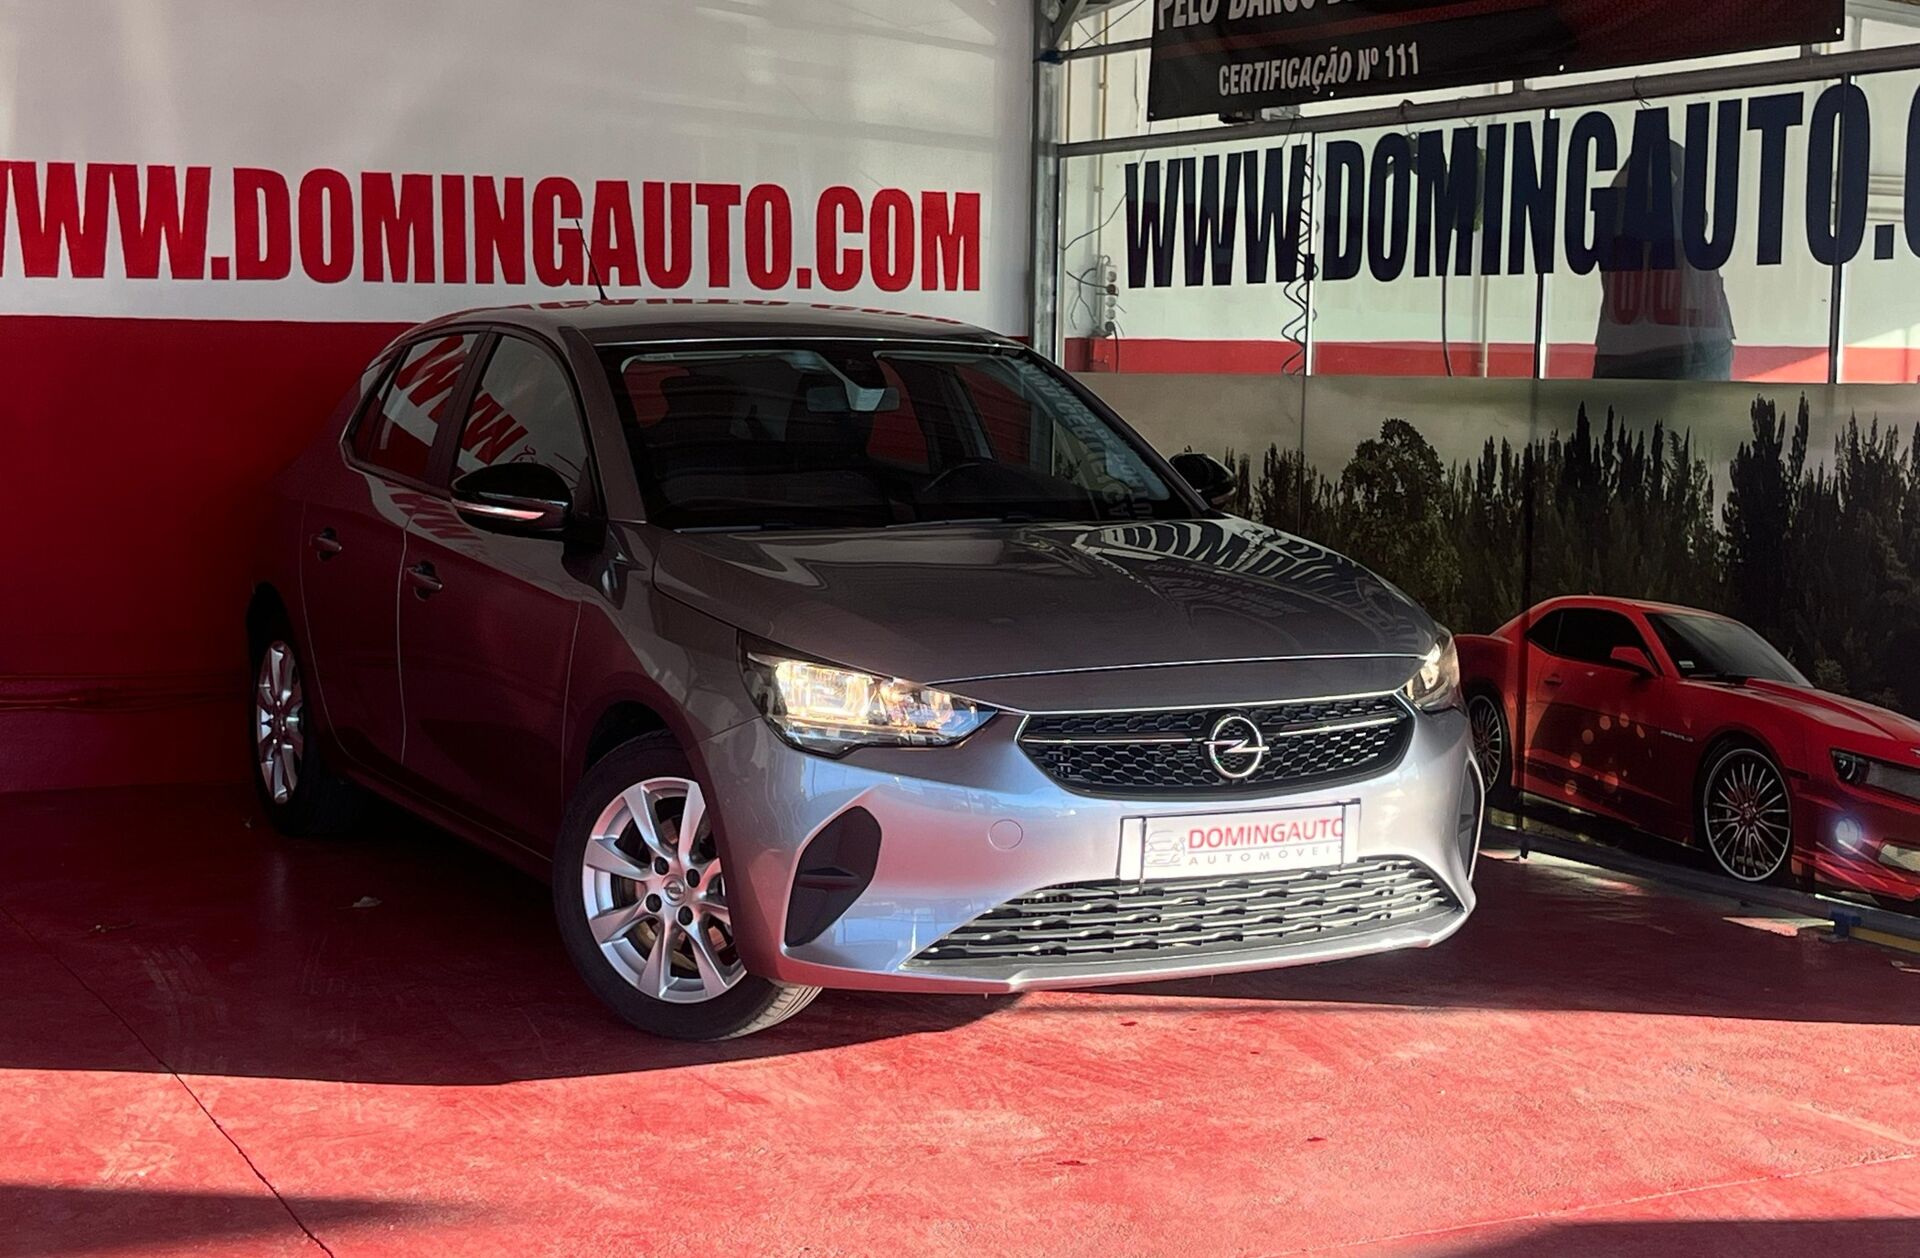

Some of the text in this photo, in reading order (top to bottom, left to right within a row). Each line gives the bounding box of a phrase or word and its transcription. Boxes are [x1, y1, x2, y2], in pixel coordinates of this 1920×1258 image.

[1219, 46, 1352, 96] CERTIFICAÇÃO
[1385, 41, 1419, 78] 111
[0, 161, 980, 292] WW.DOMINGAUTO.COM
[1125, 84, 1920, 289] WWW.DOMINGAUTO.
[1188, 818, 1343, 849] DOMINGAUTO
